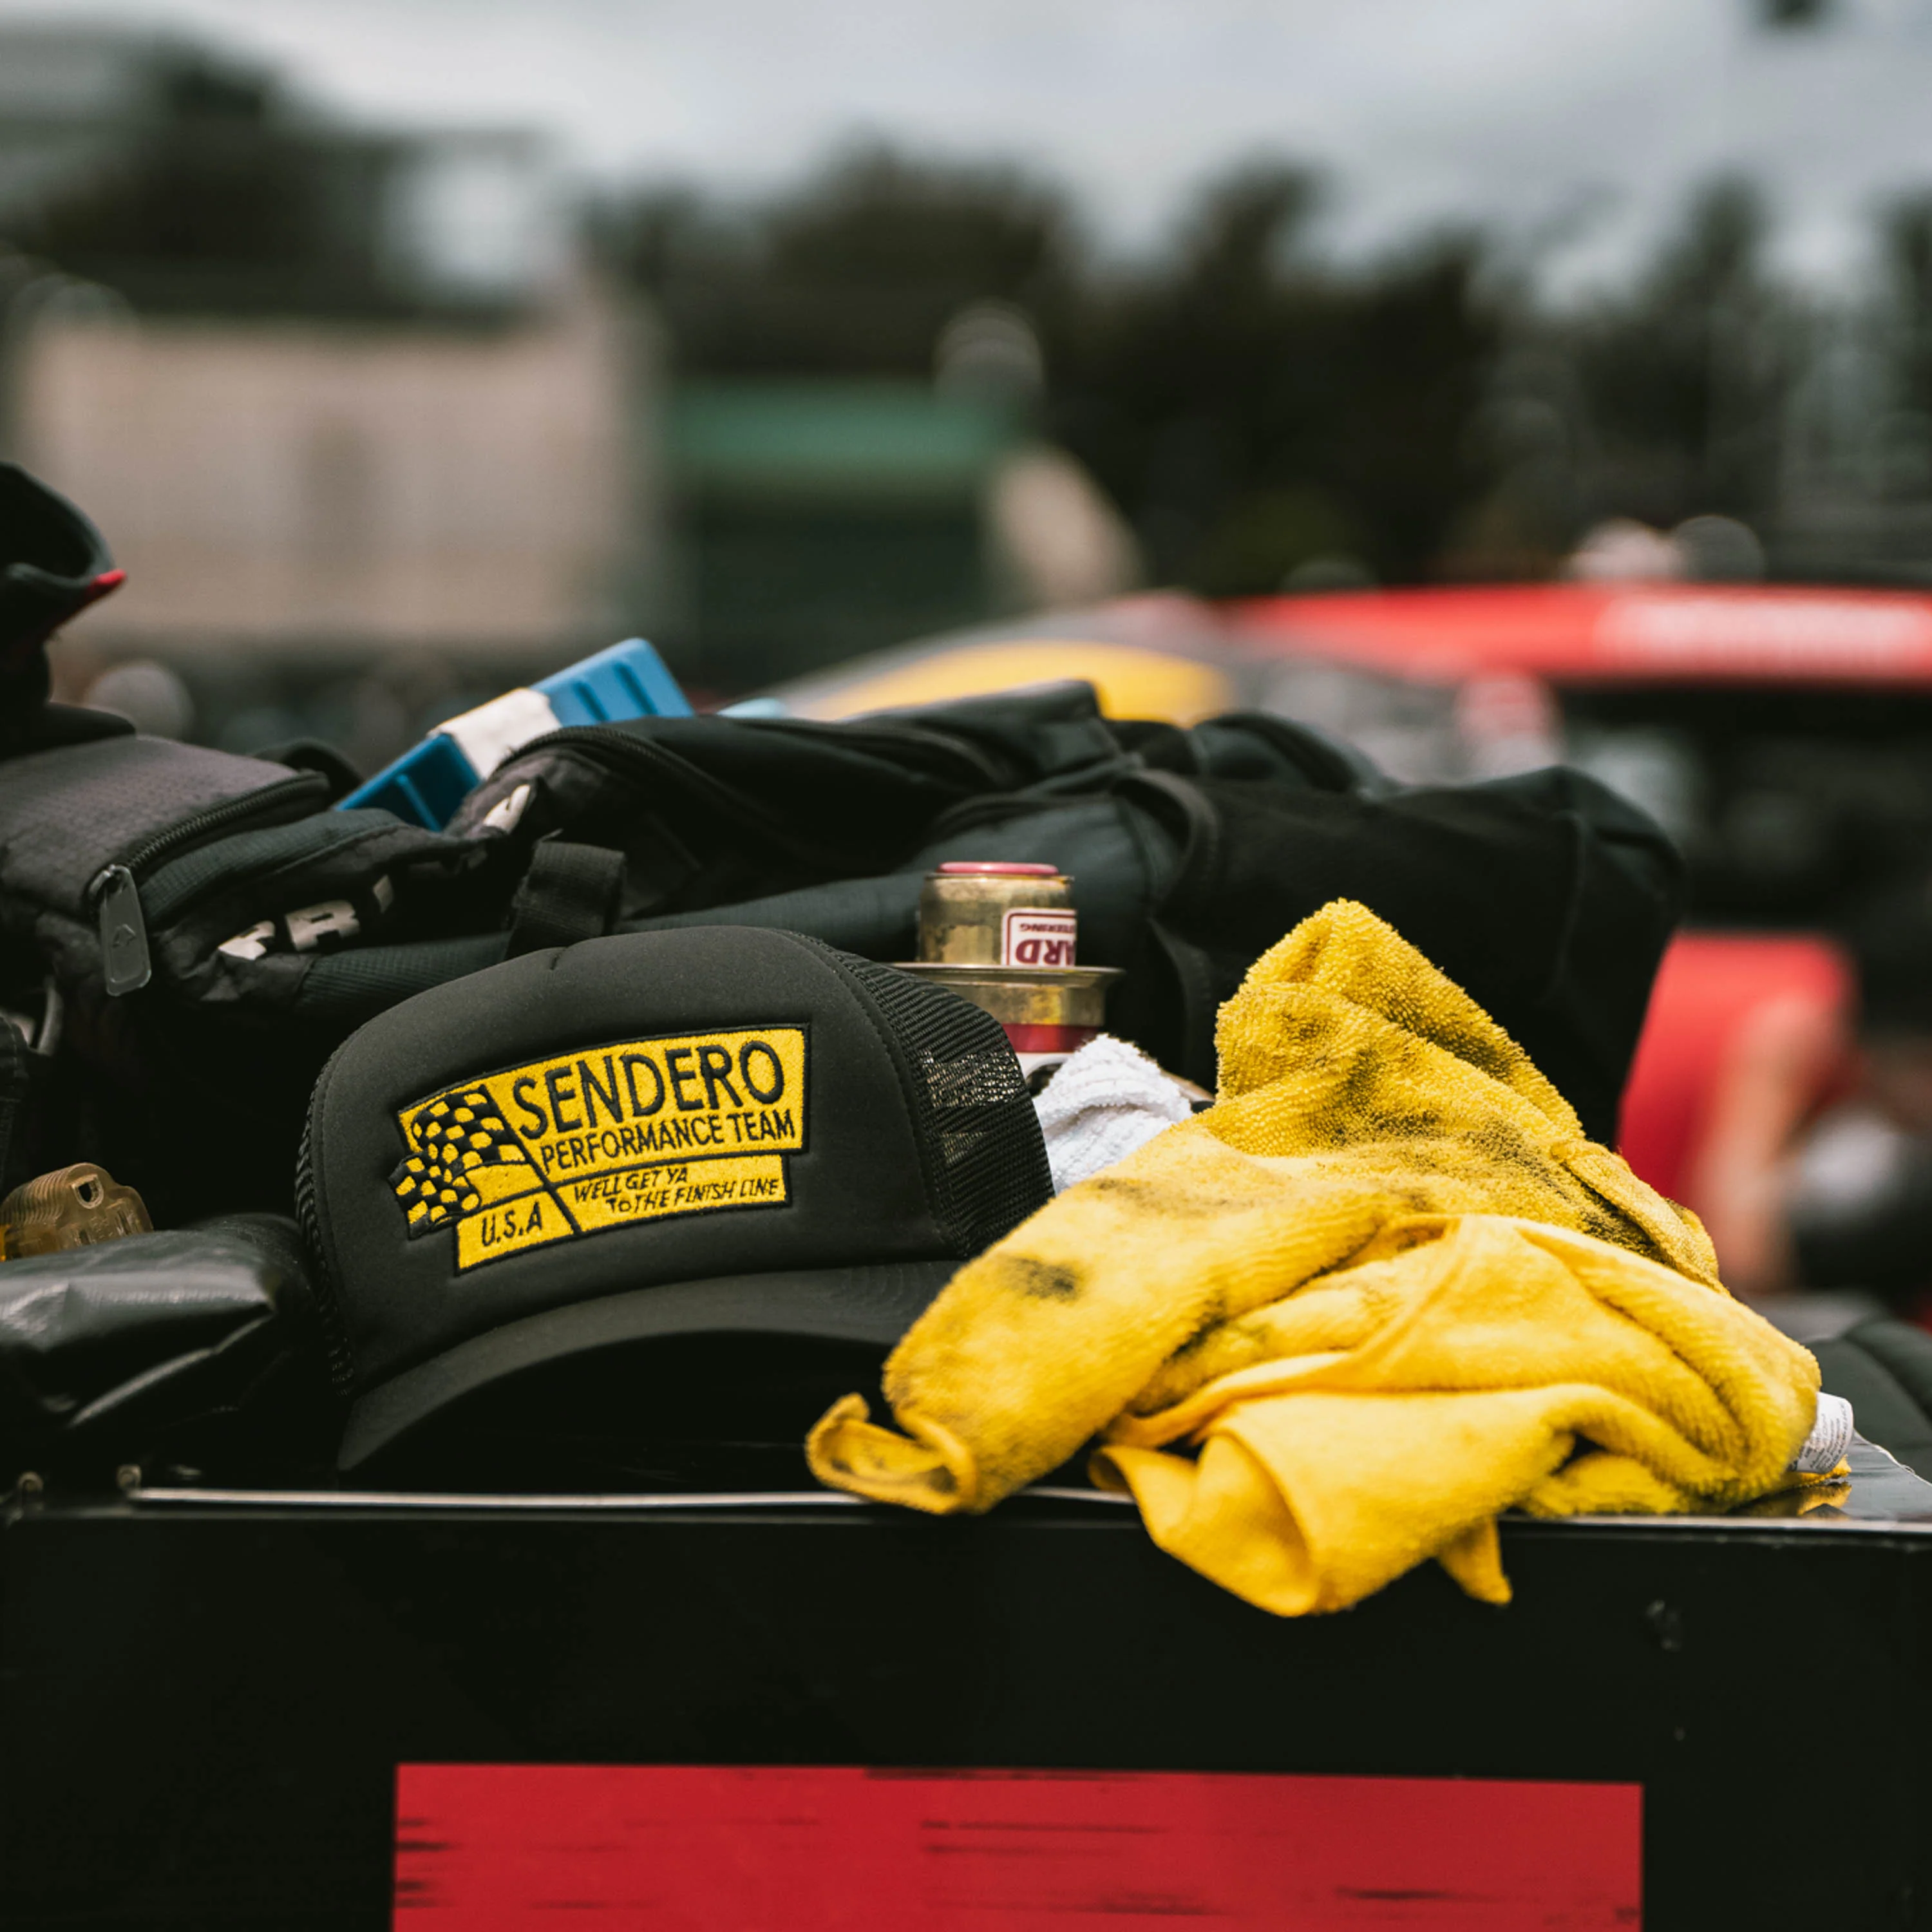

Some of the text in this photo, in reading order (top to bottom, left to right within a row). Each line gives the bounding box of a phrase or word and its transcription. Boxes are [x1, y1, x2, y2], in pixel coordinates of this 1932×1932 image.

[513, 1040, 784, 1140] SENDERO
[540, 1109, 795, 1175] PERFORMANCE TEAM
[625, 1170, 661, 1190] GET
[667, 1167, 688, 1184] YA
[634, 1189, 670, 1213] THE
[674, 1180, 737, 1206] FINISH
[740, 1178, 780, 1197] LINE
[481, 1200, 542, 1247] U.S.A
